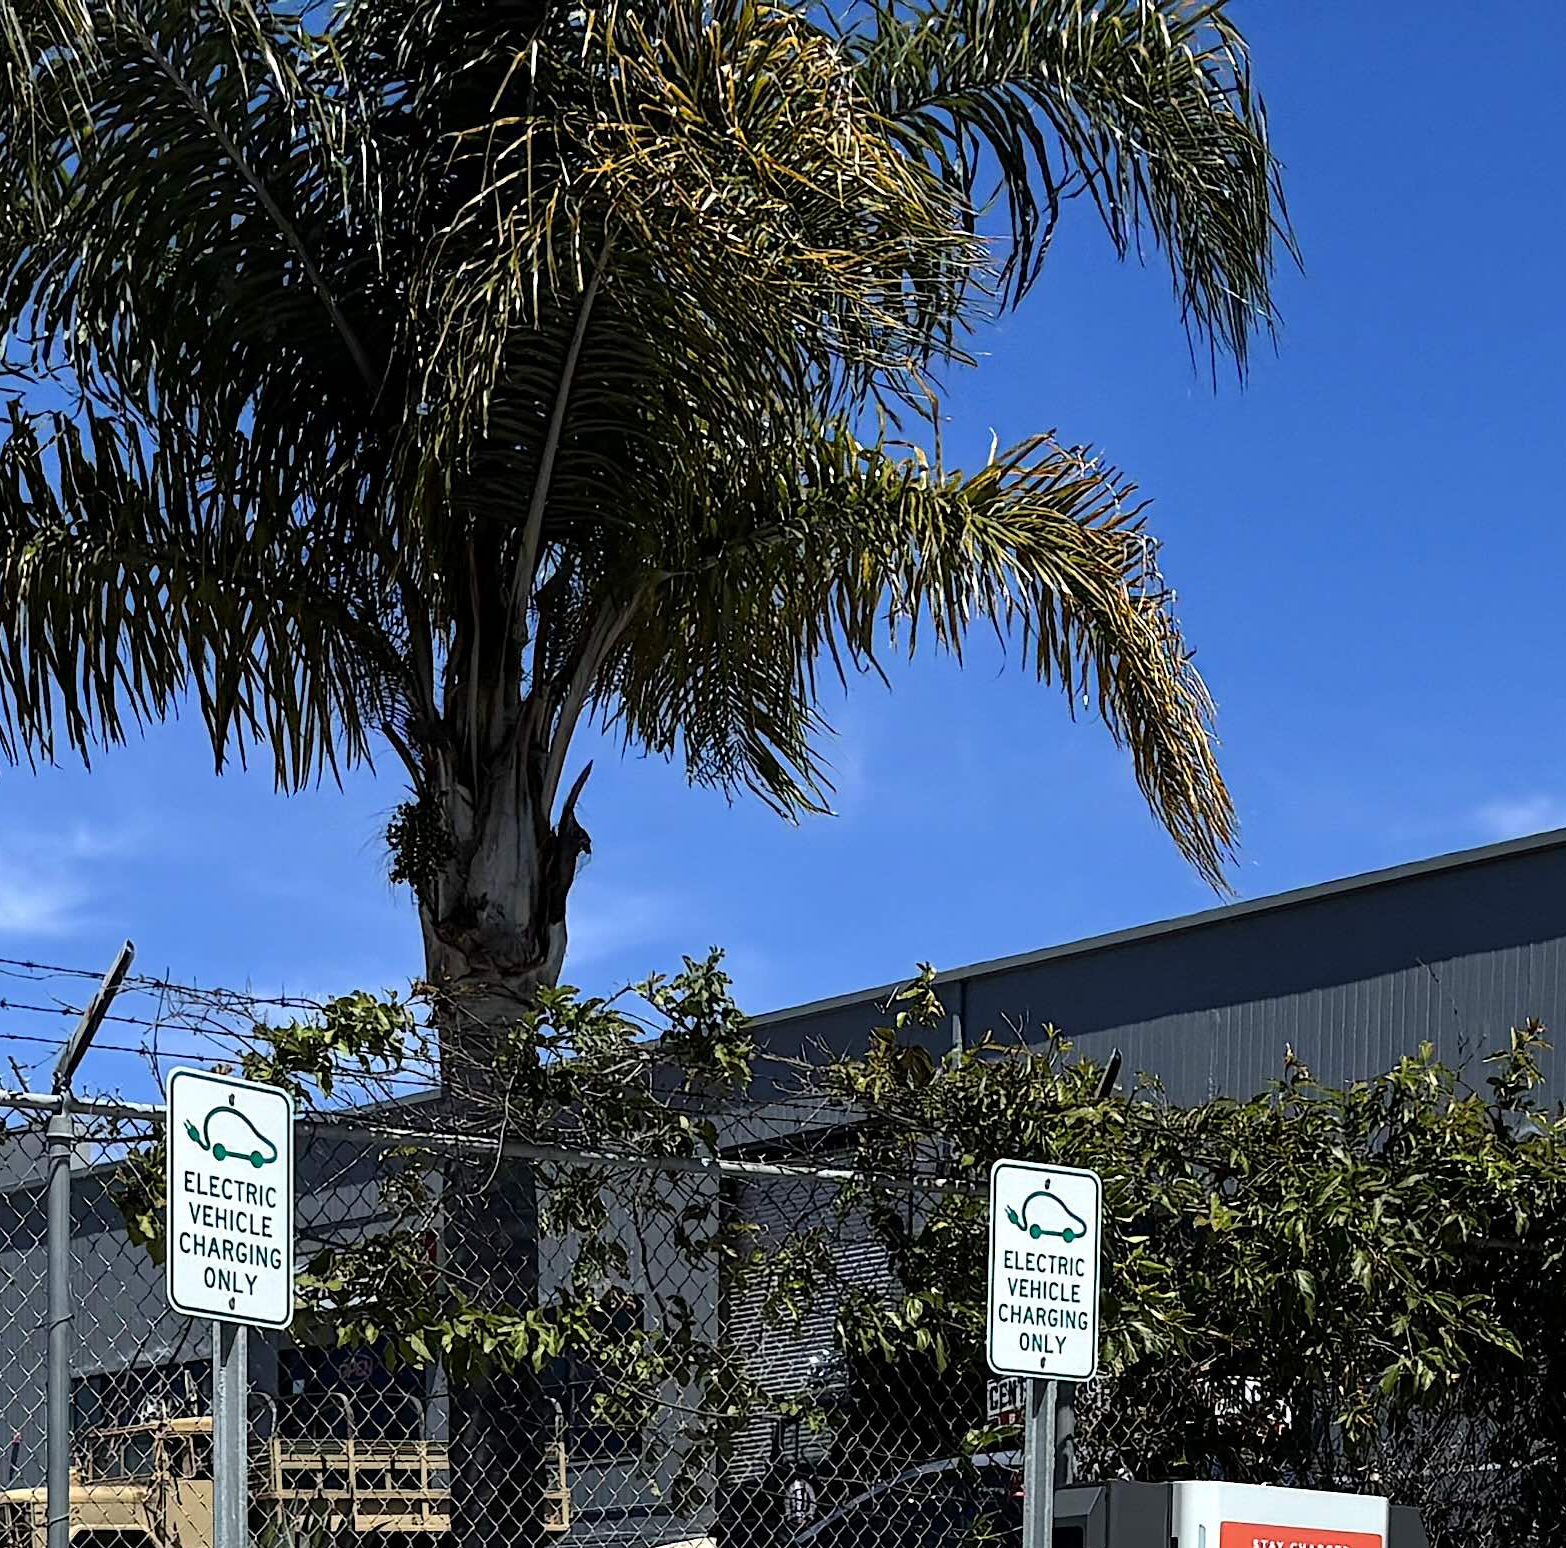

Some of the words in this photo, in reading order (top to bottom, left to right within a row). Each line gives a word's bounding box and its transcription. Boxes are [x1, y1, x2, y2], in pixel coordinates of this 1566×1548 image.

[185, 1171, 276, 1208] ELECTRIC
[189, 1202, 272, 1238] VEHICLE
[180, 1232, 281, 1269] CHARGING
[1005, 1250, 1084, 1277] ELECTRIC
[204, 1267, 257, 1296] ONLY
[1007, 1278, 1080, 1303] VEHICLE
[999, 1304, 1088, 1330] CHARGING
[1020, 1332, 1066, 1355] ONLY
